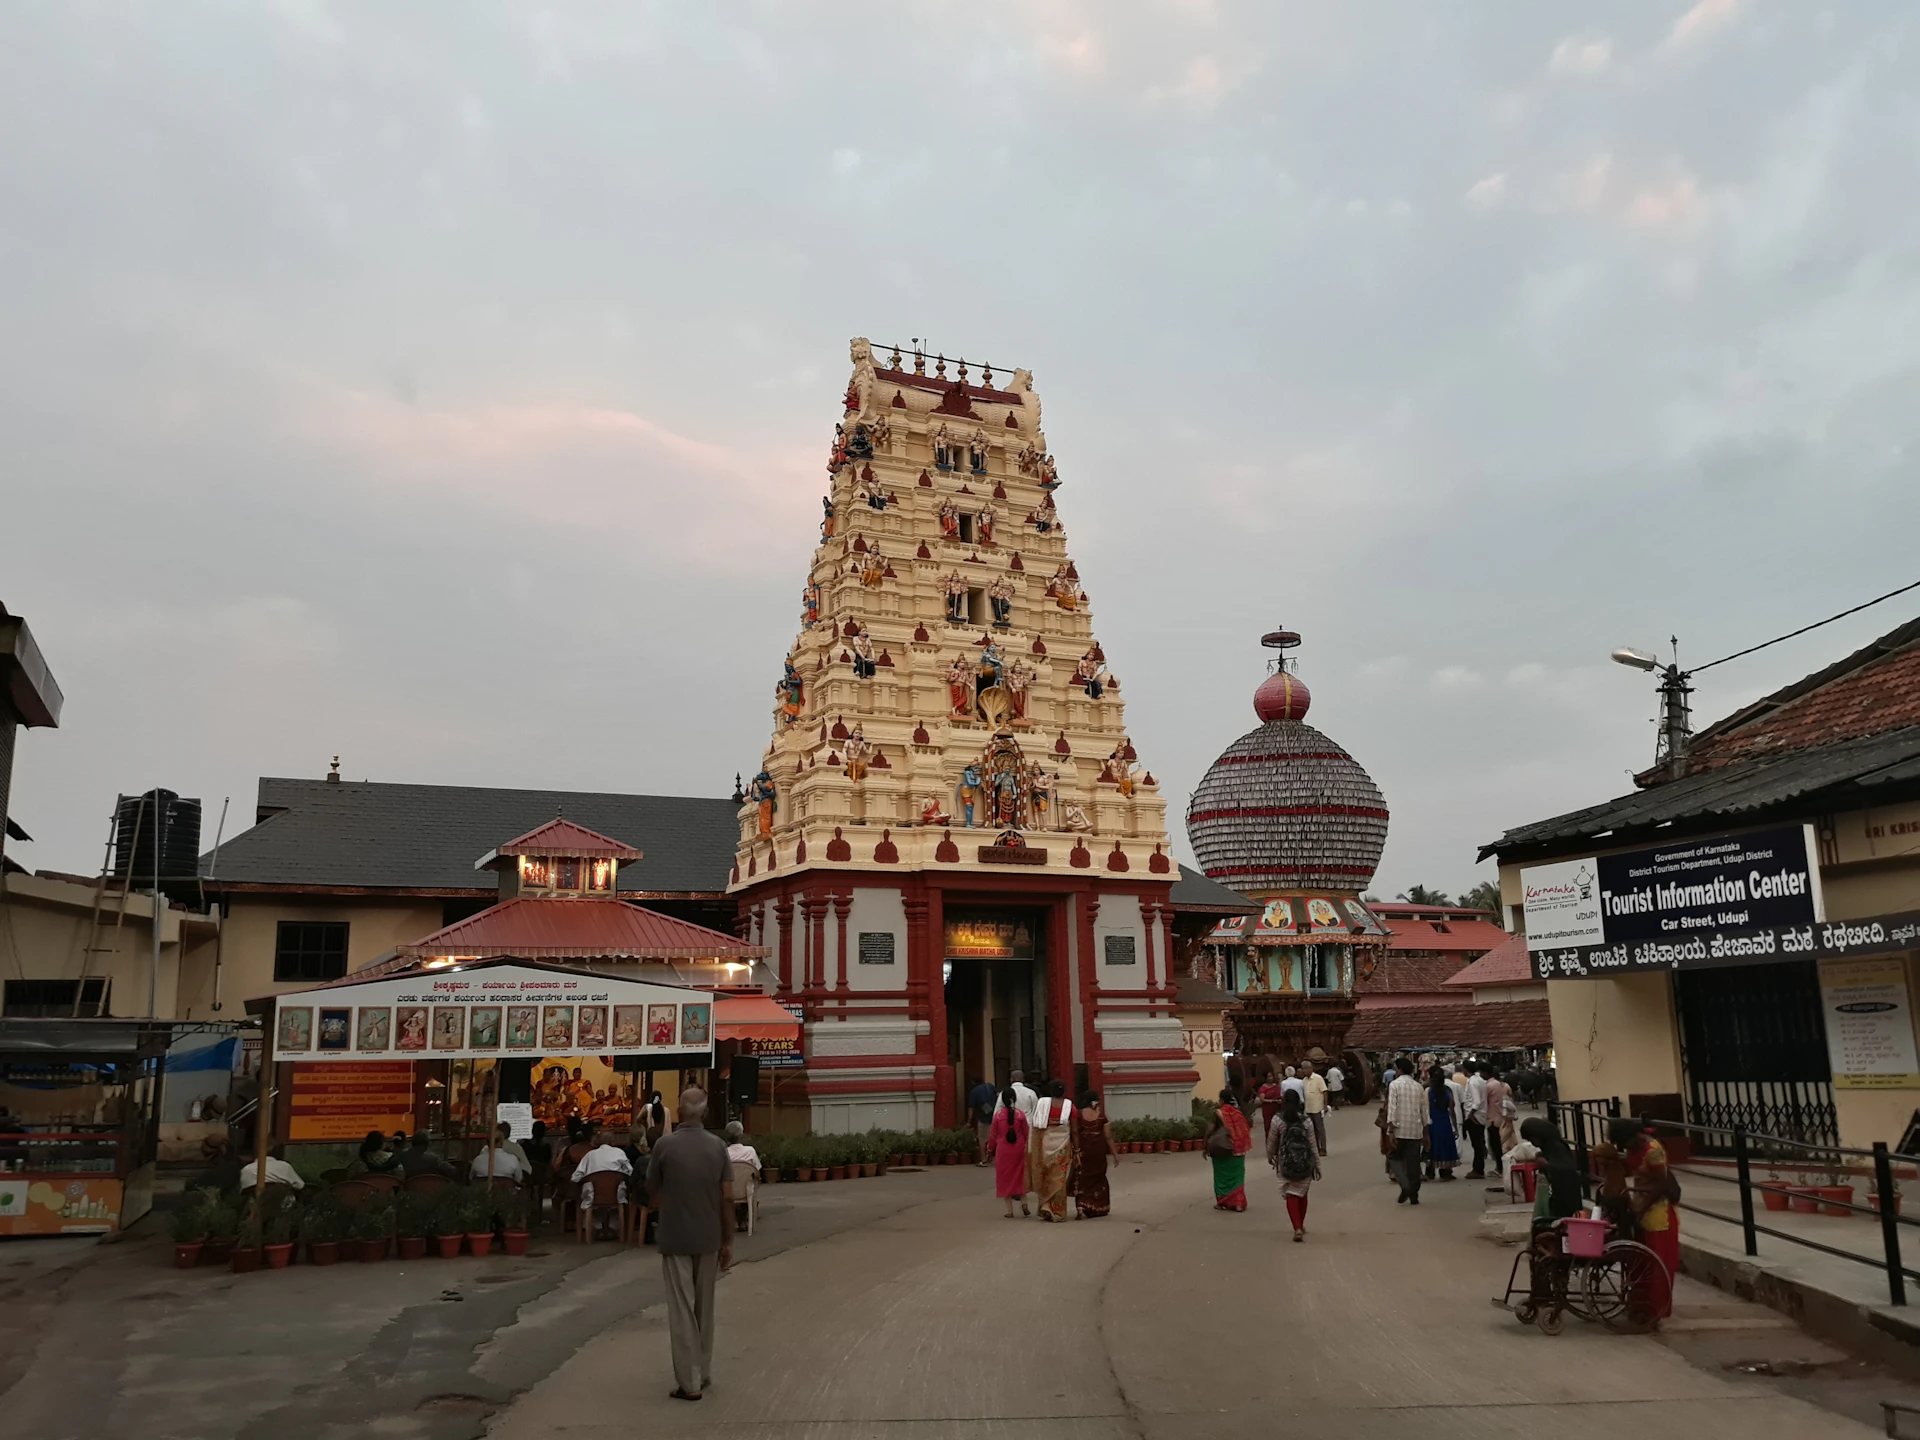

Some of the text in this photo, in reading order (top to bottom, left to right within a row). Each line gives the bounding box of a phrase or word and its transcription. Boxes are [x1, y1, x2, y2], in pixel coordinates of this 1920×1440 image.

[1890, 821, 1920, 836] KRIS
[1654, 842, 1741, 863] Government of Karnataka
[1629, 849, 1773, 878] District Tourism Department, Udupi District
[1525, 883, 1576, 903] Karnataka
[1602, 868, 1807, 917] Tourist Information Center
[1526, 905, 1552, 913] Department
[1575, 910, 1598, 920] UDUPI
[1661, 910, 1749, 931] Car Street, Udupi
[1528, 926, 1600, 941] www.udupitourism.com
[958, 947, 978, 956] KRISHNA
[1538, 950, 1555, 979] ಶ್ರೀ
[1559, 948, 1588, 976] ಕೃಷ್ಣ
[1589, 943, 1628, 967] ಉಚಿತ
[752, 1041, 795, 1050] 2 YEARS
